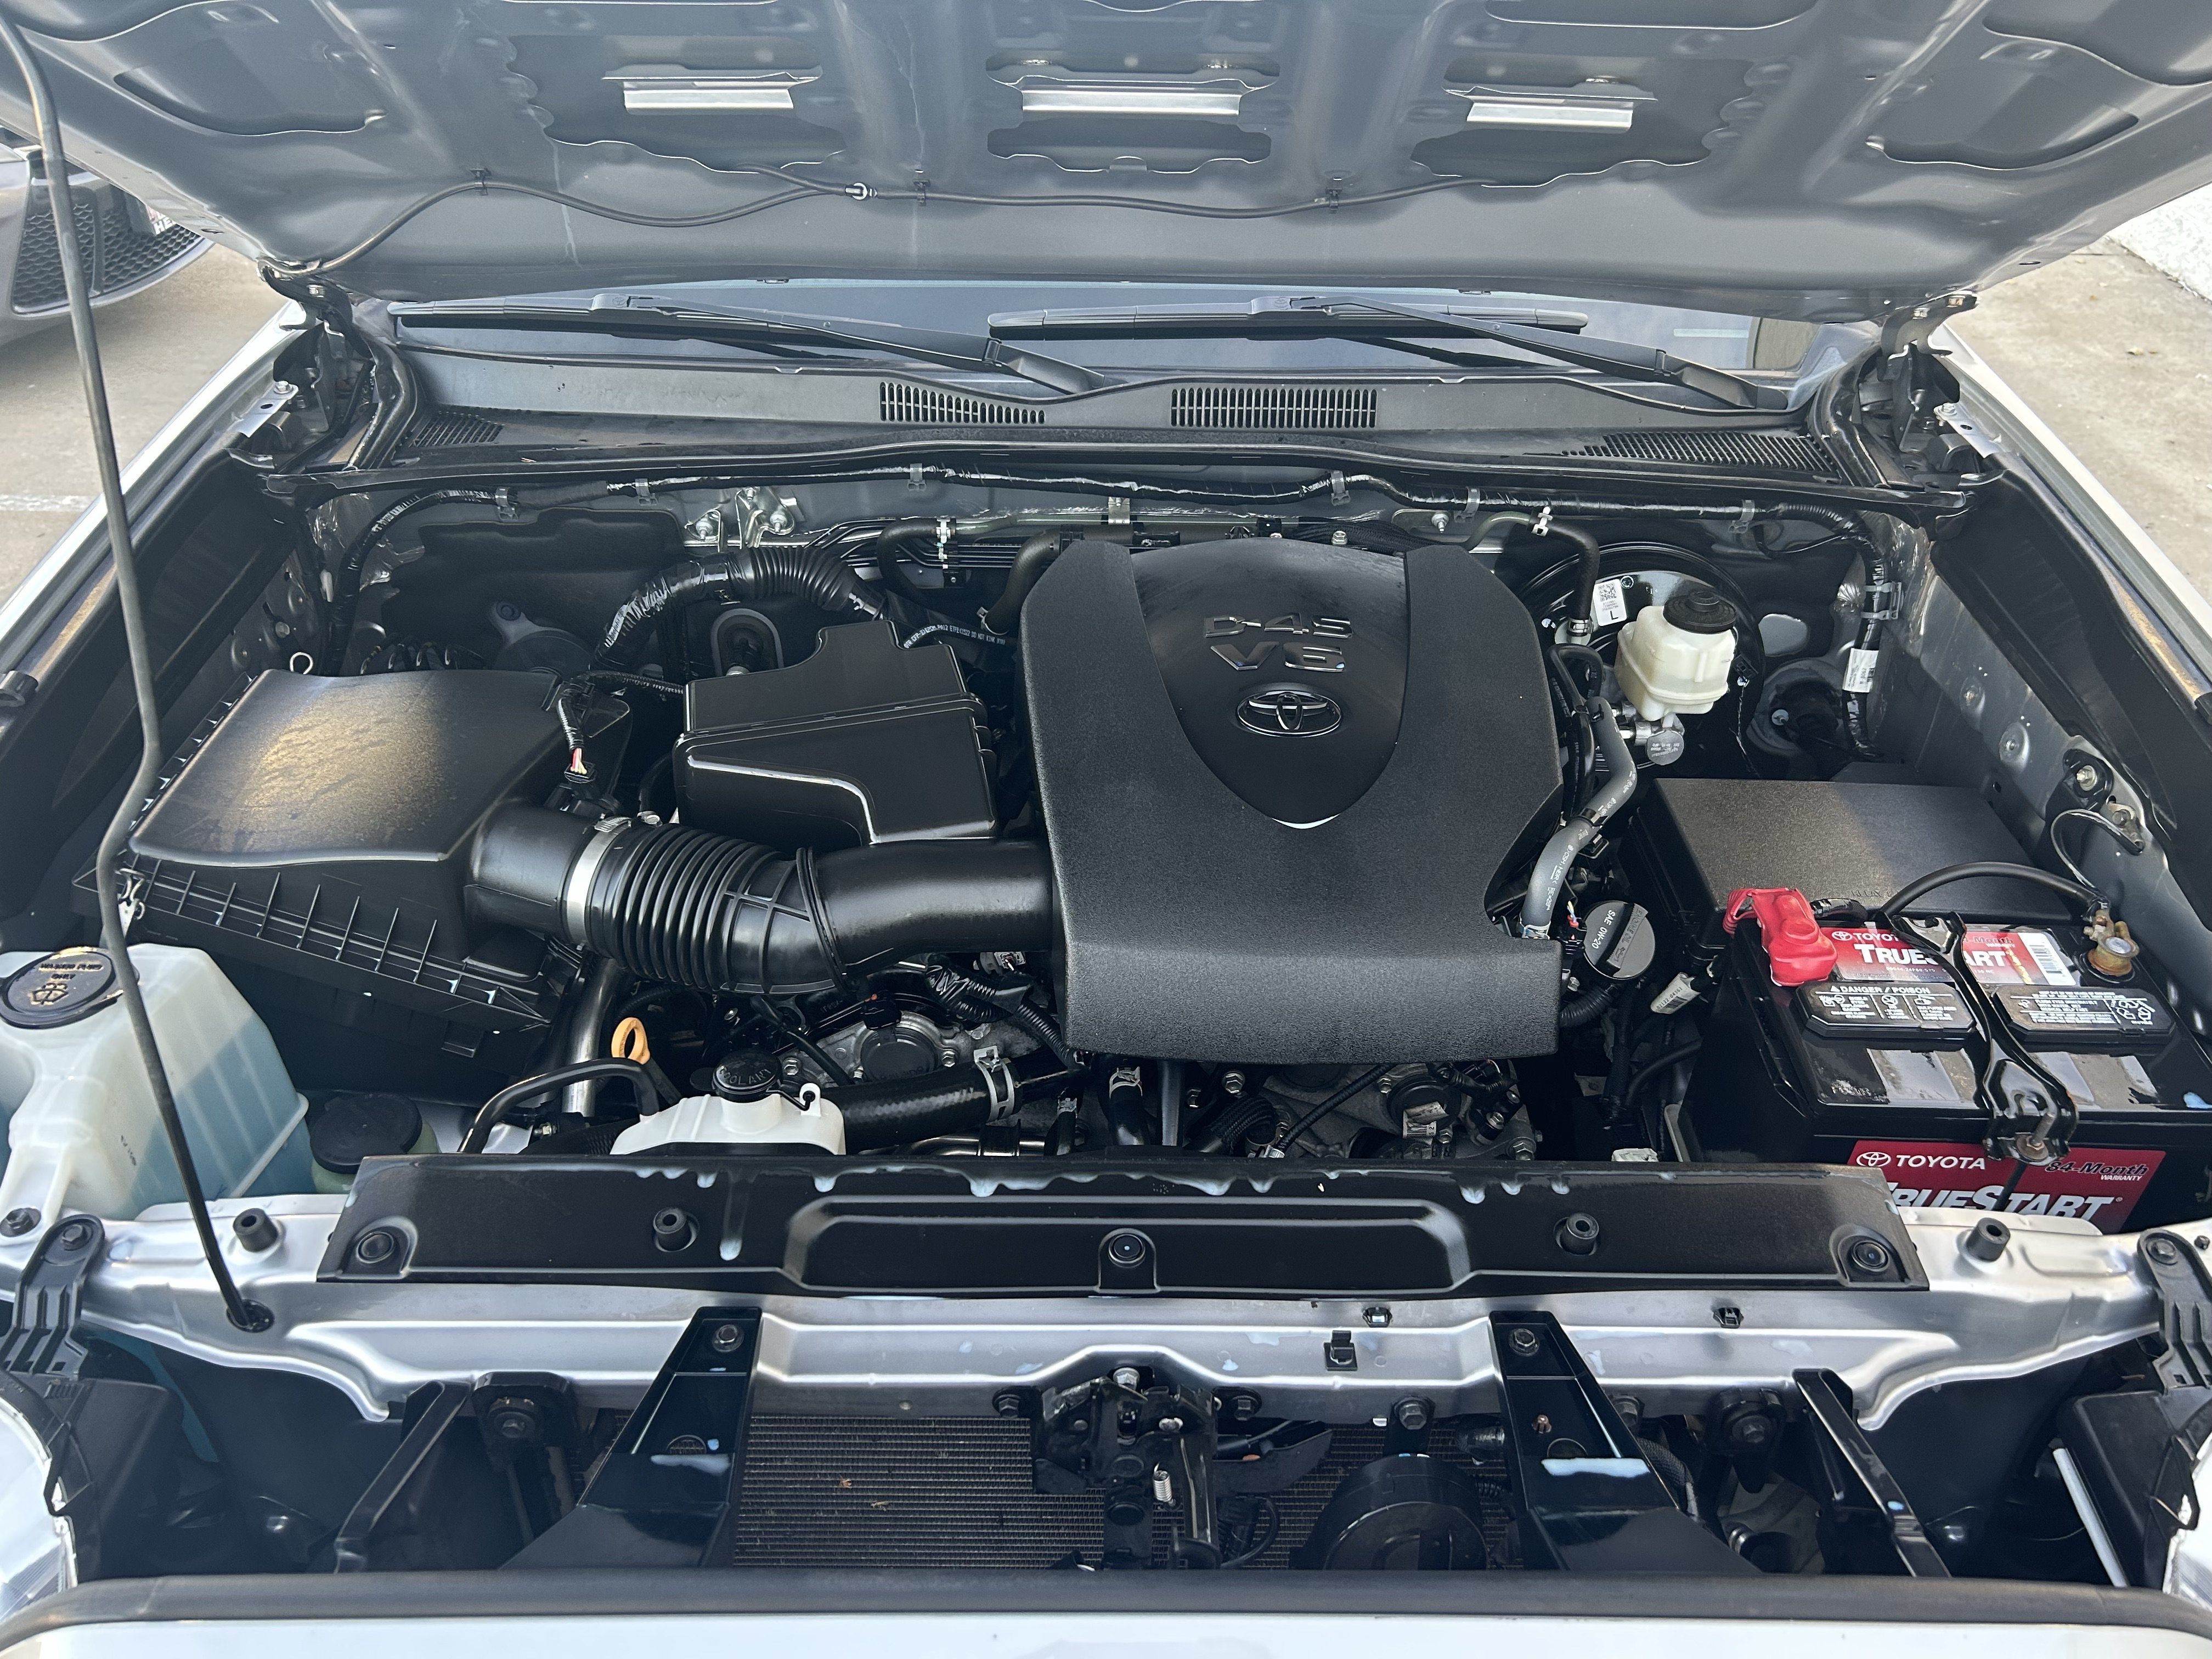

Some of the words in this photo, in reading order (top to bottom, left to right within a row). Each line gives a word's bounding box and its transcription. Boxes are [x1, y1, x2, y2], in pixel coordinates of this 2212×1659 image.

[1610, 610, 1619, 620] L
[1210, 641, 1346, 673] V6
[1604, 910, 1616, 926] SAE
[719, 1067, 771, 1085] COOLANT
[1895, 1154, 1985, 1170] TOYOTA
[2044, 1161, 2149, 1176] 84-Month
